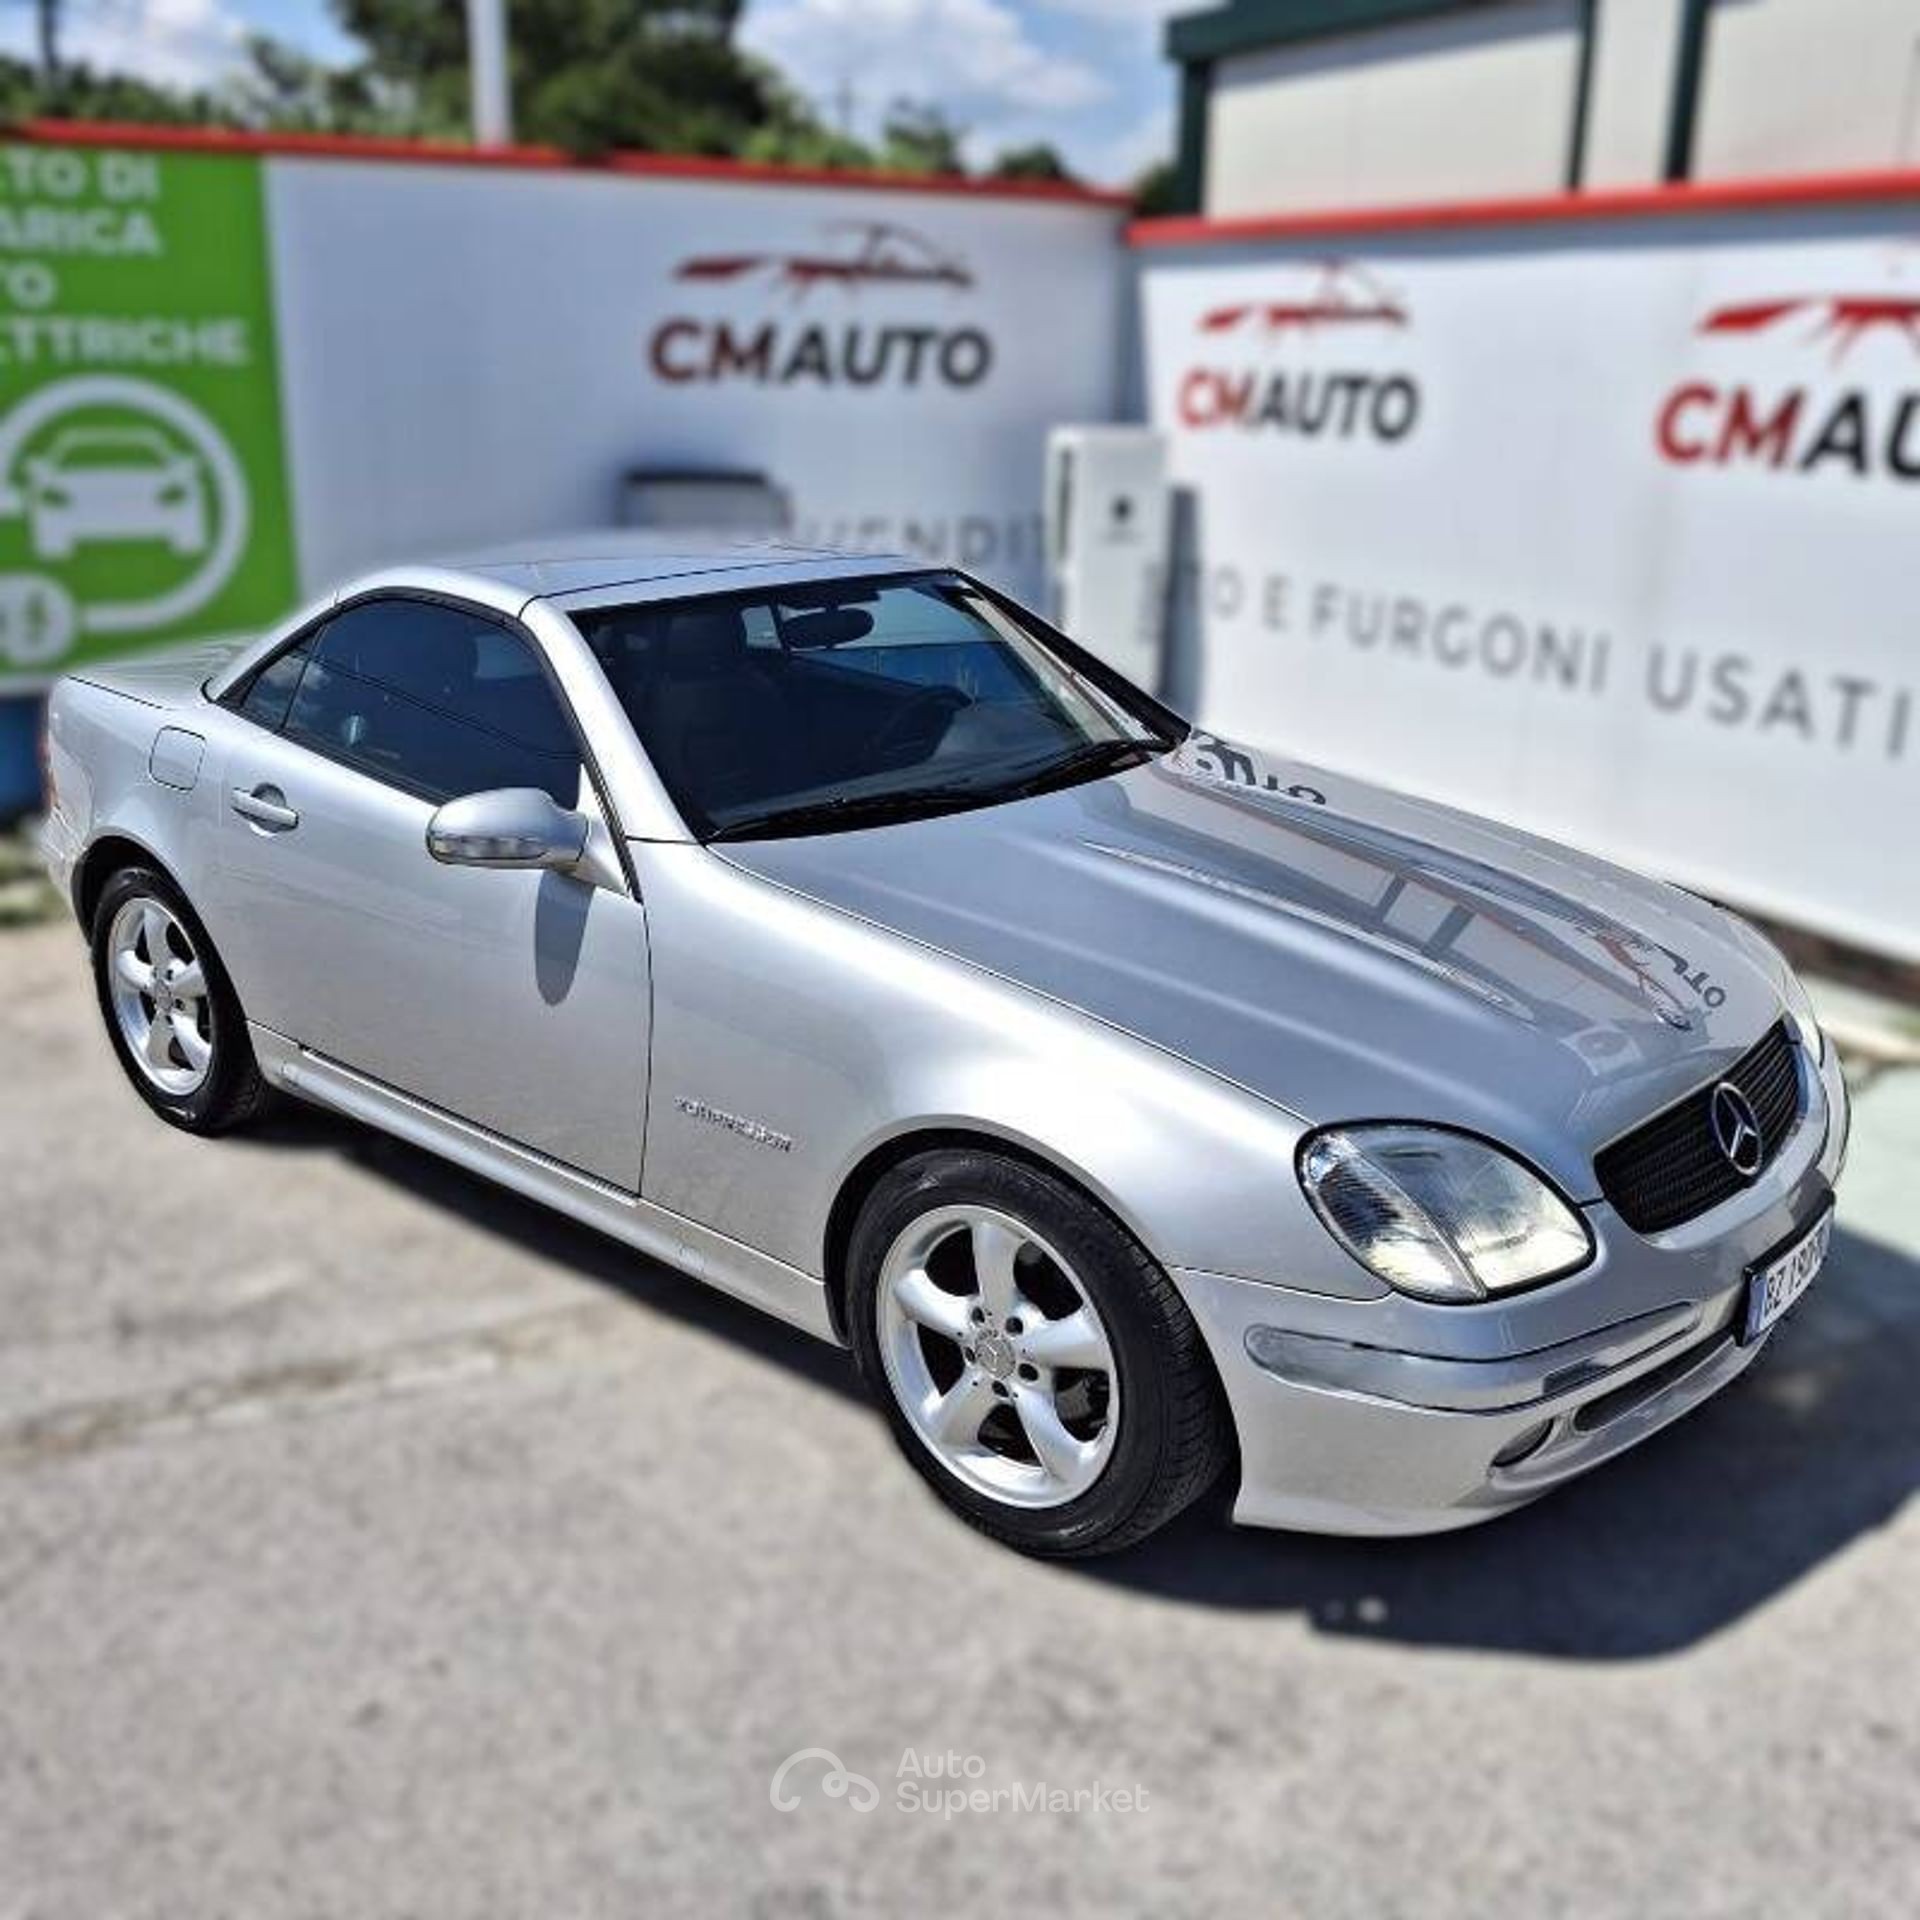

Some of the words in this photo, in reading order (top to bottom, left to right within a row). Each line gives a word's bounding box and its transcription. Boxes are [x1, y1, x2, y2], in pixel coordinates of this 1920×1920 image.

[0, 147, 87, 199] TO
[99, 152, 160, 201] DI
[0, 316, 248, 366] TTRICHE
[649, 319, 992, 388] CMAUTO
[1177, 367, 1420, 444] CMAUTO
[1261, 573, 1290, 632] E
[1310, 581, 1612, 694] FURGONI
[1644, 642, 1914, 761] USATI
